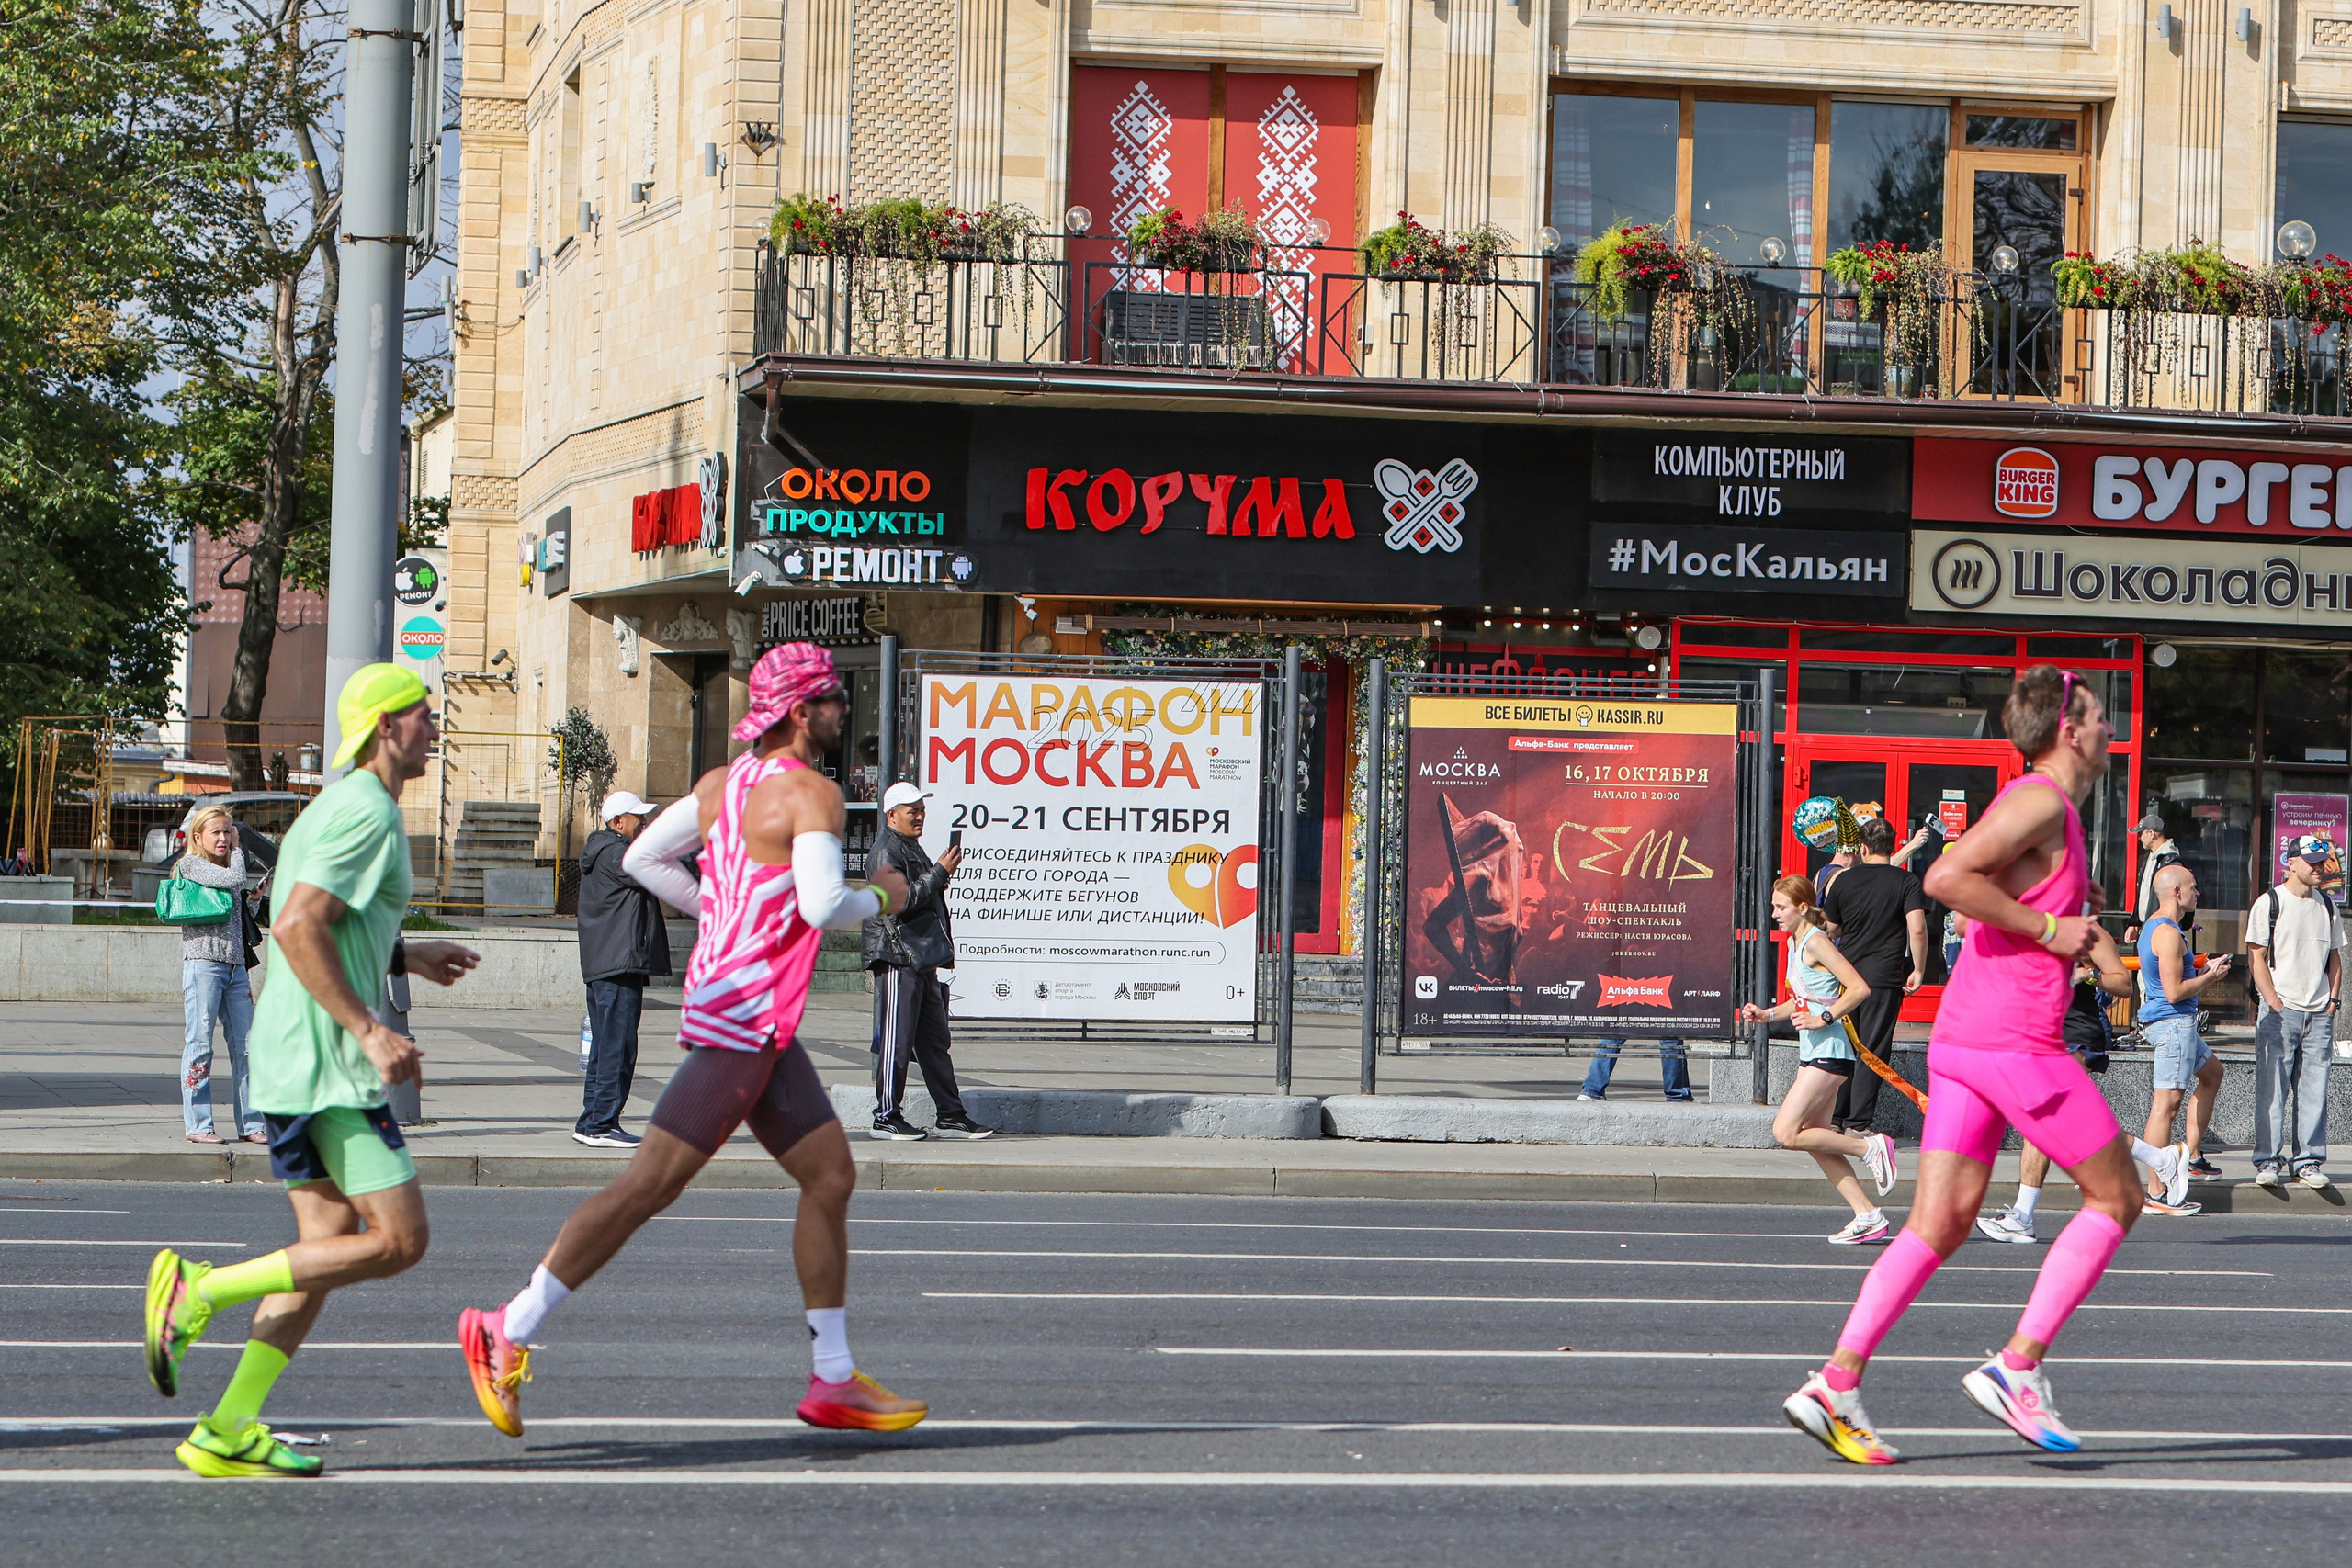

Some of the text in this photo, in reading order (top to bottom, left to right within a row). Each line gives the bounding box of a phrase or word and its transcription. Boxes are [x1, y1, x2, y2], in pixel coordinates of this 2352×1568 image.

[1654, 445, 1845, 480] КОМПЬЮТЕРНЫЙ
[1998, 468, 2056, 485] BURGER
[781, 468, 931, 504] ОКОЛО
[1997, 482, 2055, 503] KING
[1025, 467, 1356, 540] КОРЧМА
[1719, 485, 1781, 516] КЛУБ
[766, 508, 944, 538] ПРОДУКТЫ
[812, 547, 944, 584] РЕМОНТ
[1608, 538, 1888, 582] #МосКальян
[2011, 549, 2352, 612] Шоколадн
[400, 591, 433, 600] РЕМОНТ
[770, 597, 860, 637] PRICE COFFEE
[401, 634, 444, 645] ОКОЛО
[929, 681, 1253, 737] МАРАФОН
[1485, 705, 1664, 725] ВСЕ БИЛЕТЫ KASSIR.RU
[1026, 706, 1156, 751] 2025
[1514, 739, 1634, 751] Альфа-Банк представляет
[928, 736, 1201, 790] МОСКВА
[1419, 762, 1501, 778] МОСКВА
[1594, 765, 1611, 780] 17
[1617, 766, 1709, 782] ОКТЯБРЯ
[1593, 790, 1680, 801] НАЧАЛО В 20:00
[1062, 806, 1230, 834] СЕНТЯБРЯ
[960, 847, 1229, 865] РИСОЕДИНЯЙТЕСЬ К ПРАЗДНИКУ
[950, 867, 983, 882] ДЛЯ
[988, 869, 1038, 882] ВСЕГО
[1043, 870, 1109, 884] ГОРОДА
[949, 887, 1139, 903] ПОДДЕРЖИТЕ БЕГУНОВ
[1583, 902, 1687, 913] ТАНЦЕВАЛЬНЫЙ
[949, 908, 1204, 927] НА ФИНИШЕ ИЛИ ДИСТАНЦИИ!
[1587, 916, 1682, 926] ШОУ-СПЕКТАКЛЬ
[958, 943, 1211, 958] Подробности: moscowmarathon.runc.run
[1133, 981, 1181, 992] МОСКОВСКИЙ
[1226, 986, 1246, 1000] 0+
[1419, 983, 1434, 993] VK
[1607, 986, 1664, 998] Альфа Банк
[1133, 992, 1155, 1001] СПОРТ
[1413, 1013, 1438, 1025] 18+
